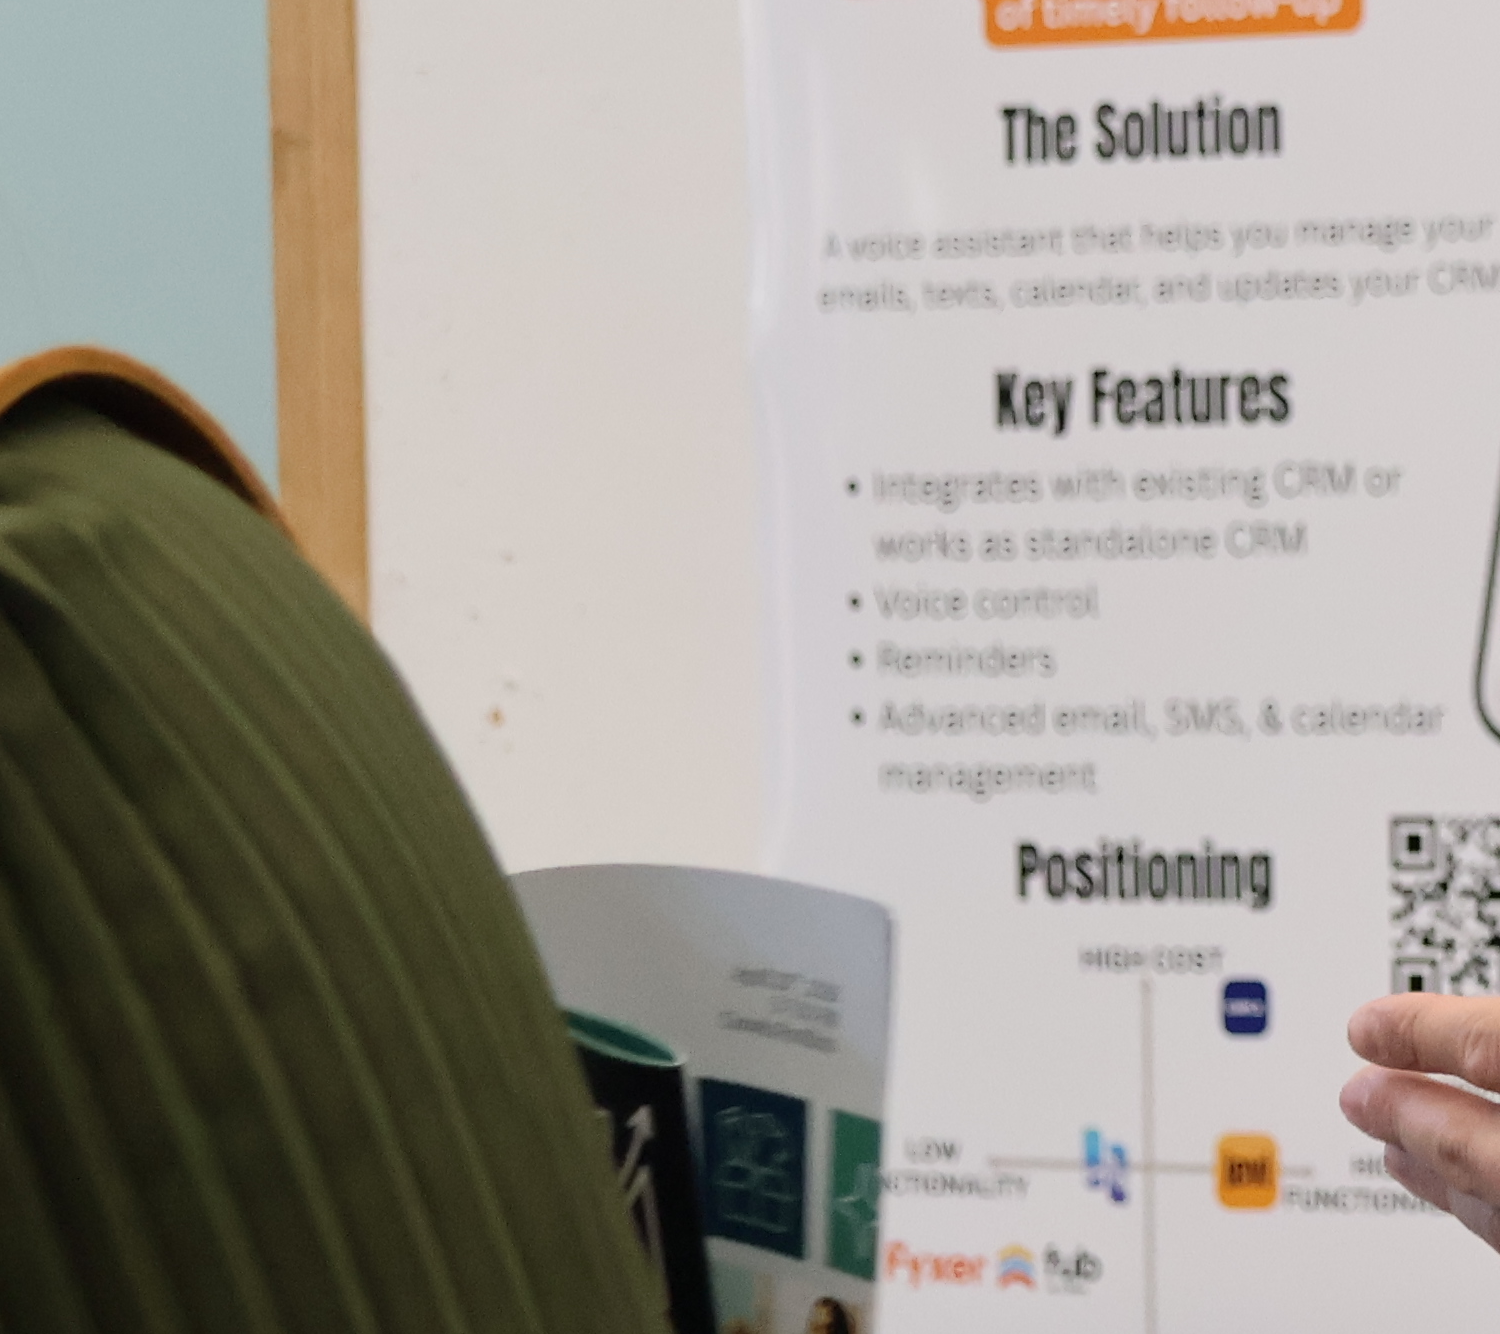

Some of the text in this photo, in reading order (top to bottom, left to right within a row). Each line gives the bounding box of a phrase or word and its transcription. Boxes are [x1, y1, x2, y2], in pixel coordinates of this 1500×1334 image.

[1000, 96, 1281, 165] The Solution
[822, 213, 1495, 261] A voice assistant that helps you manage your
[818, 259, 1500, 315] emails, texts, calendar, and updates your CRM
[995, 367, 1291, 438] Key Features
[872, 458, 1405, 513] Integrates with existing CRM or
[874, 519, 1308, 561] works as standalone CRM
[874, 585, 1100, 621] Voice control
[876, 642, 1058, 678] Reminders
[880, 698, 1444, 738] Advanced email, SMS, & calendar
[878, 759, 1097, 802] management
[1016, 839, 1272, 911] Positioning
[1079, 946, 1224, 972] HIGH COST
[906, 1138, 960, 1163] LOW
[886, 1241, 986, 1289] Fyxer
